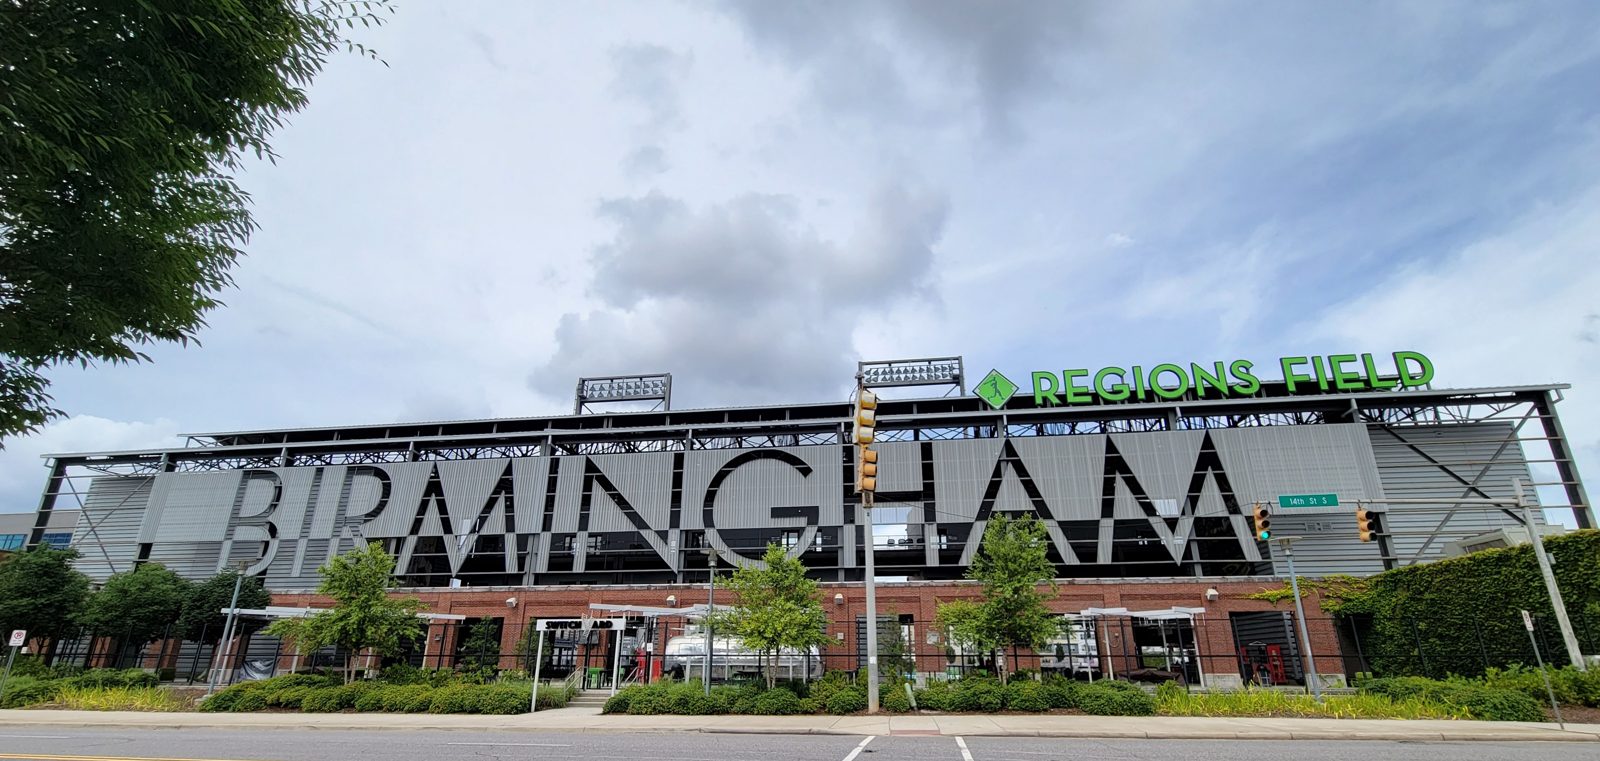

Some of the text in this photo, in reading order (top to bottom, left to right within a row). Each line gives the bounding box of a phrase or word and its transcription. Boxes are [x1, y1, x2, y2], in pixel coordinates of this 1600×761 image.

[1032, 351, 1434, 405] REGIONS FIELD
[215, 430, 1263, 578] BIRMINGHAM
[1309, 497, 1317, 505] St
